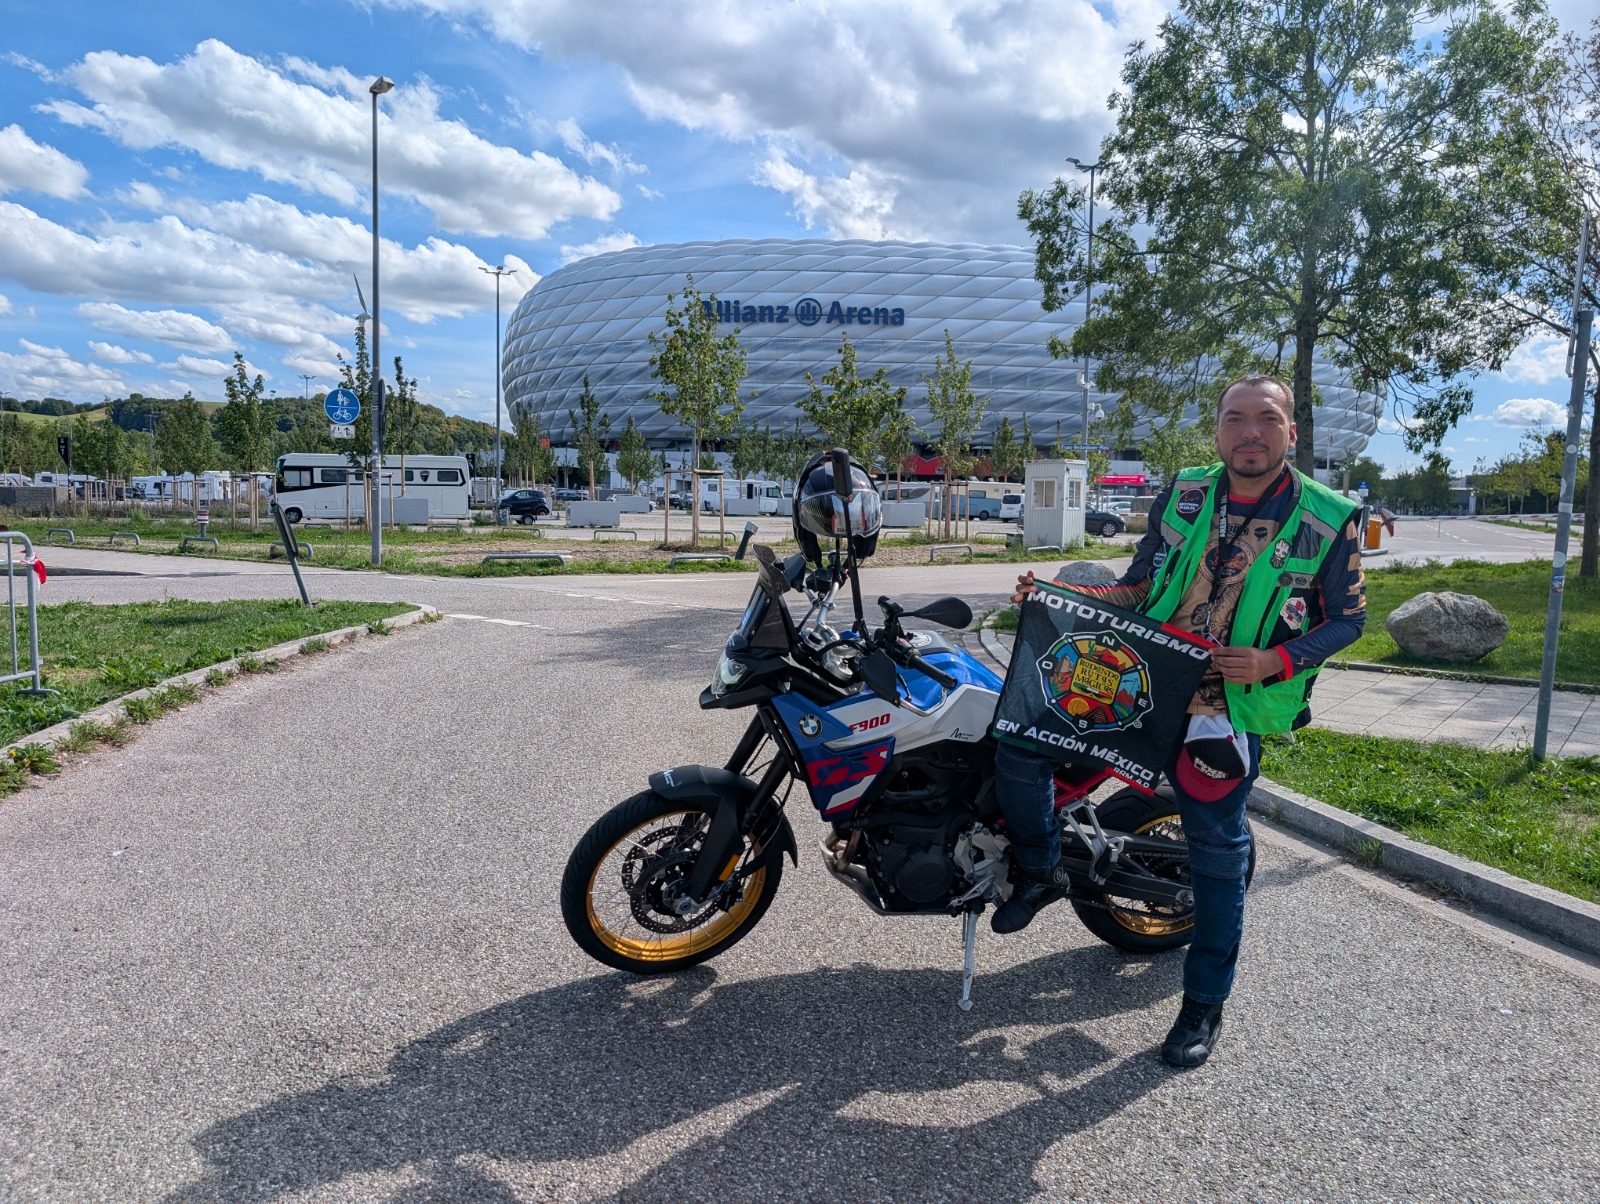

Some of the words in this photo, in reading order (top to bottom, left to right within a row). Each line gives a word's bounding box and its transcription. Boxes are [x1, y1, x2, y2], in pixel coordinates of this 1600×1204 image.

[826, 300, 905, 326] Arena
[1026, 591, 1210, 661] MOTOTURISMO
[1102, 636, 1115, 647] N
[848, 713, 891, 732] F900
[996, 719, 1021, 734] EN
[1023, 726, 1088, 754] ACCIÓN
[1090, 745, 1154, 781] MÉXICO
[1136, 778, 1151, 789] 4.0
